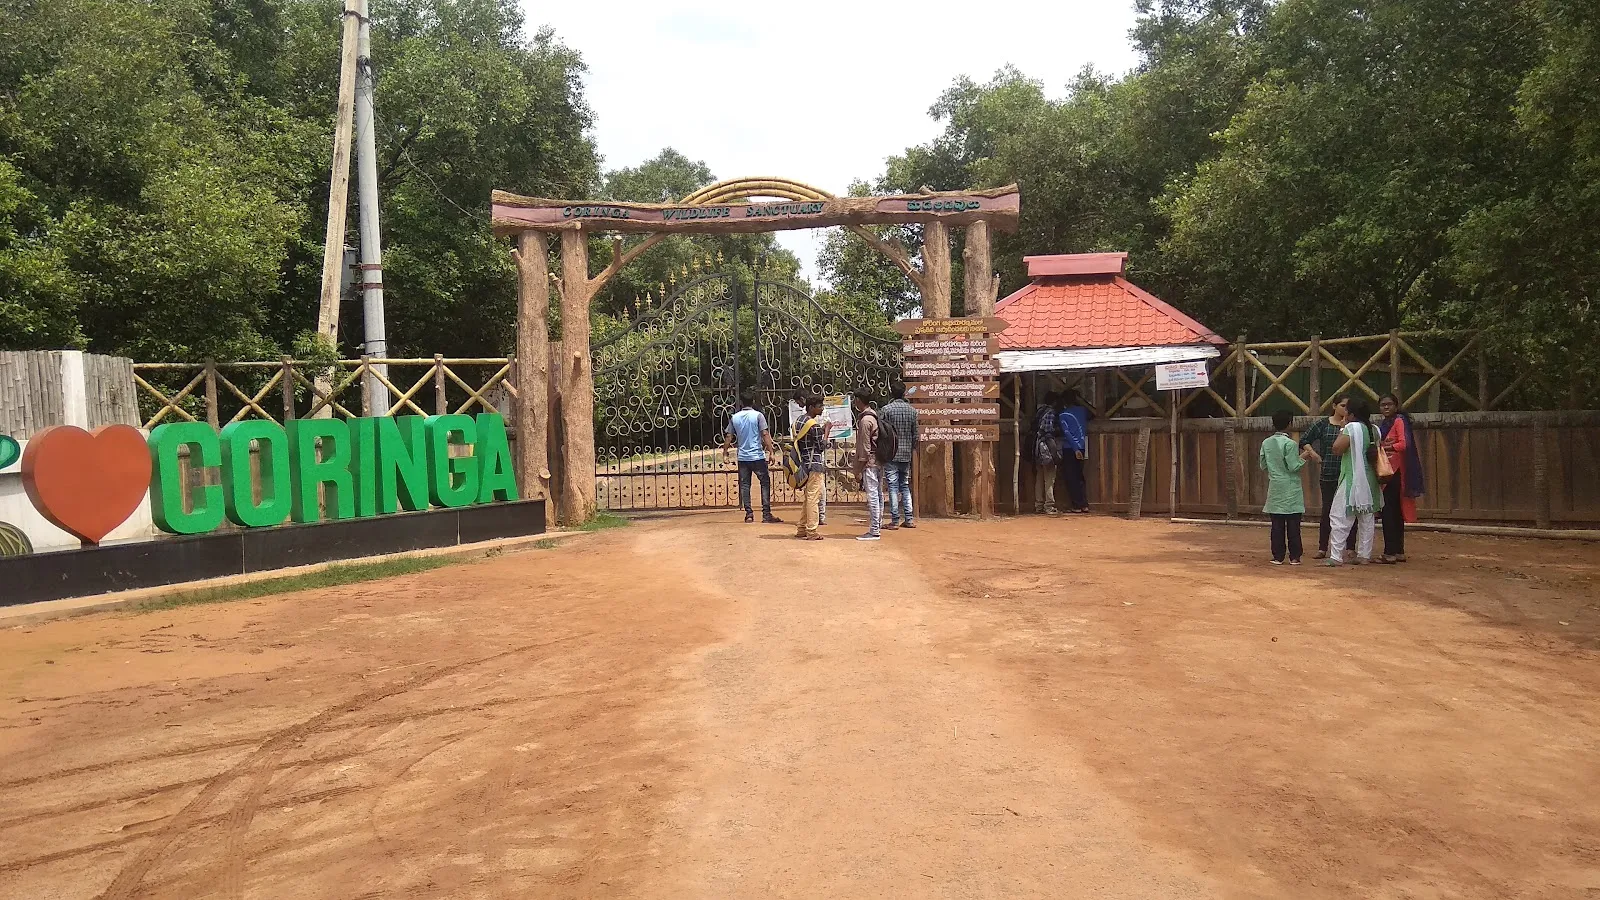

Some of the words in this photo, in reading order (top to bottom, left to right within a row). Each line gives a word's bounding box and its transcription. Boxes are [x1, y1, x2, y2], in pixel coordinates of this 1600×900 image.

[563, 206, 630, 219] CORINGA
[662, 206, 731, 221] WILDLIFE
[745, 202, 825, 217] SANCTUARY
[148, 412, 519, 534] CORINGA
